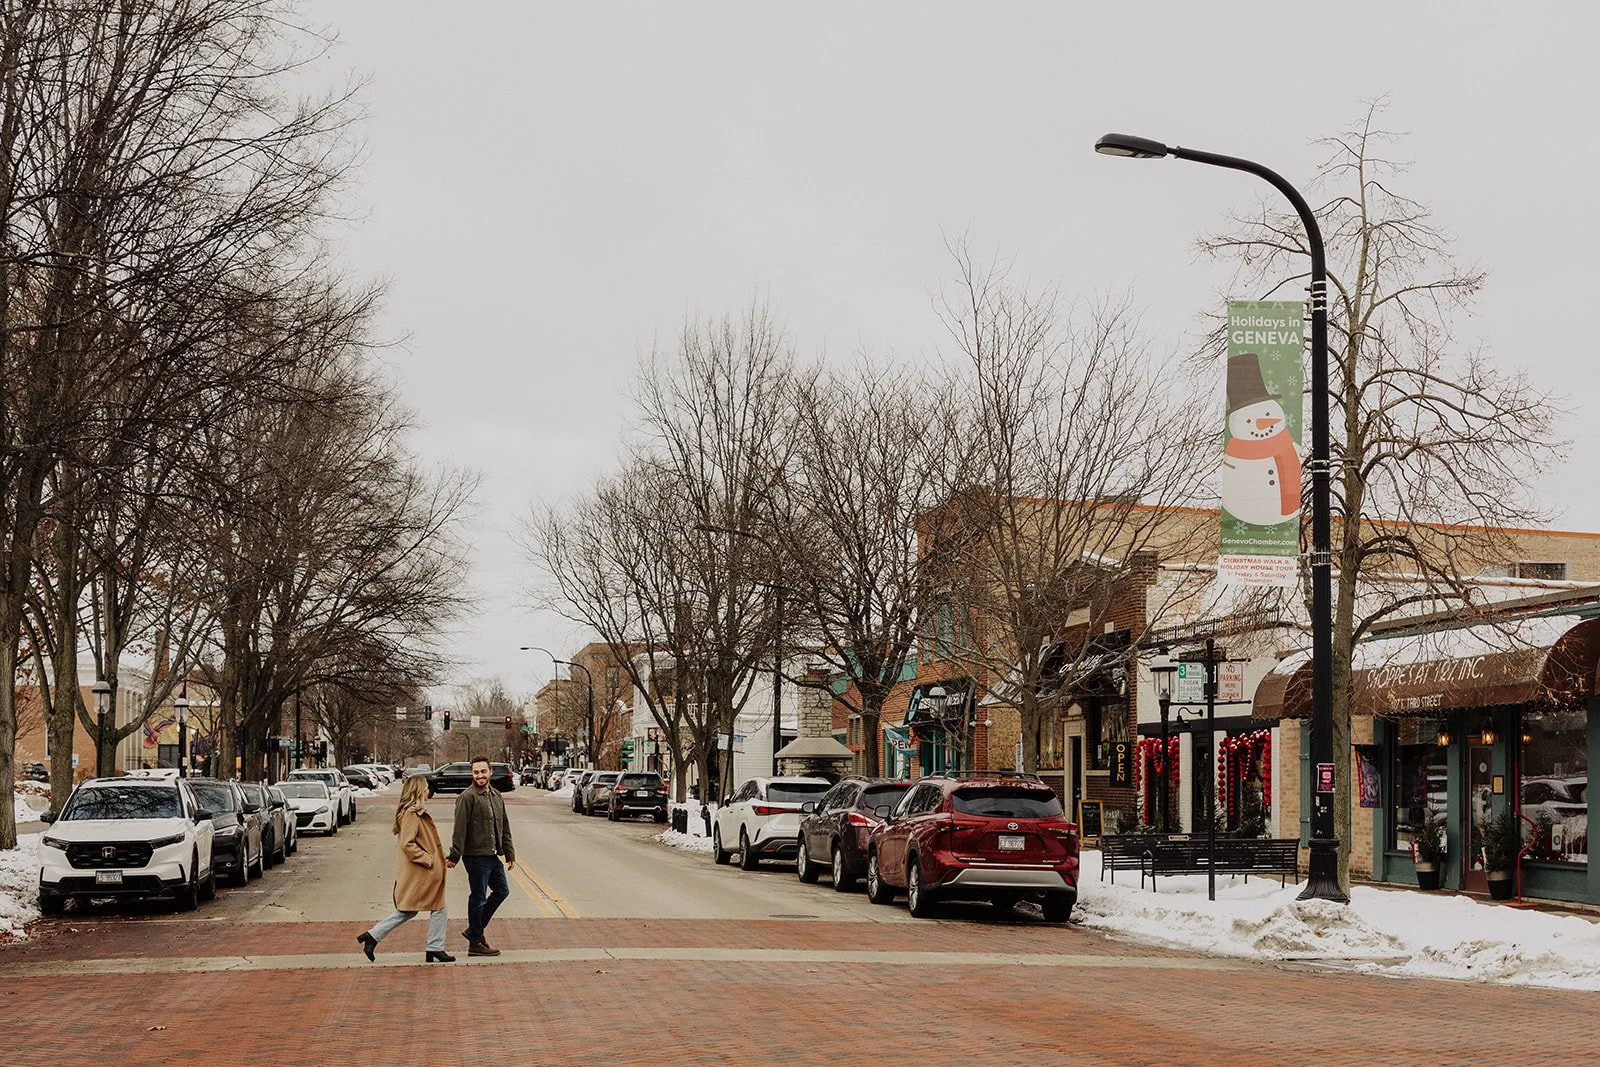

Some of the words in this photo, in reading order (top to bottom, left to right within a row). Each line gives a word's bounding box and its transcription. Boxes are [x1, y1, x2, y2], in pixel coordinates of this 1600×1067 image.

[1231, 316, 1286, 330] Holidays
[1288, 316, 1301, 327] in
[1231, 331, 1300, 345] GENEVA
[1221, 537, 1297, 546] GenevaChamber.com
[1179, 666, 1186, 676] 3
[1225, 665, 1236, 674] NO
[1458, 656, 1485, 681] INC.
[1220, 674, 1241, 682] PARKING
[1421, 693, 1444, 708] STREET
[1116, 743, 1126, 782] OPEN
